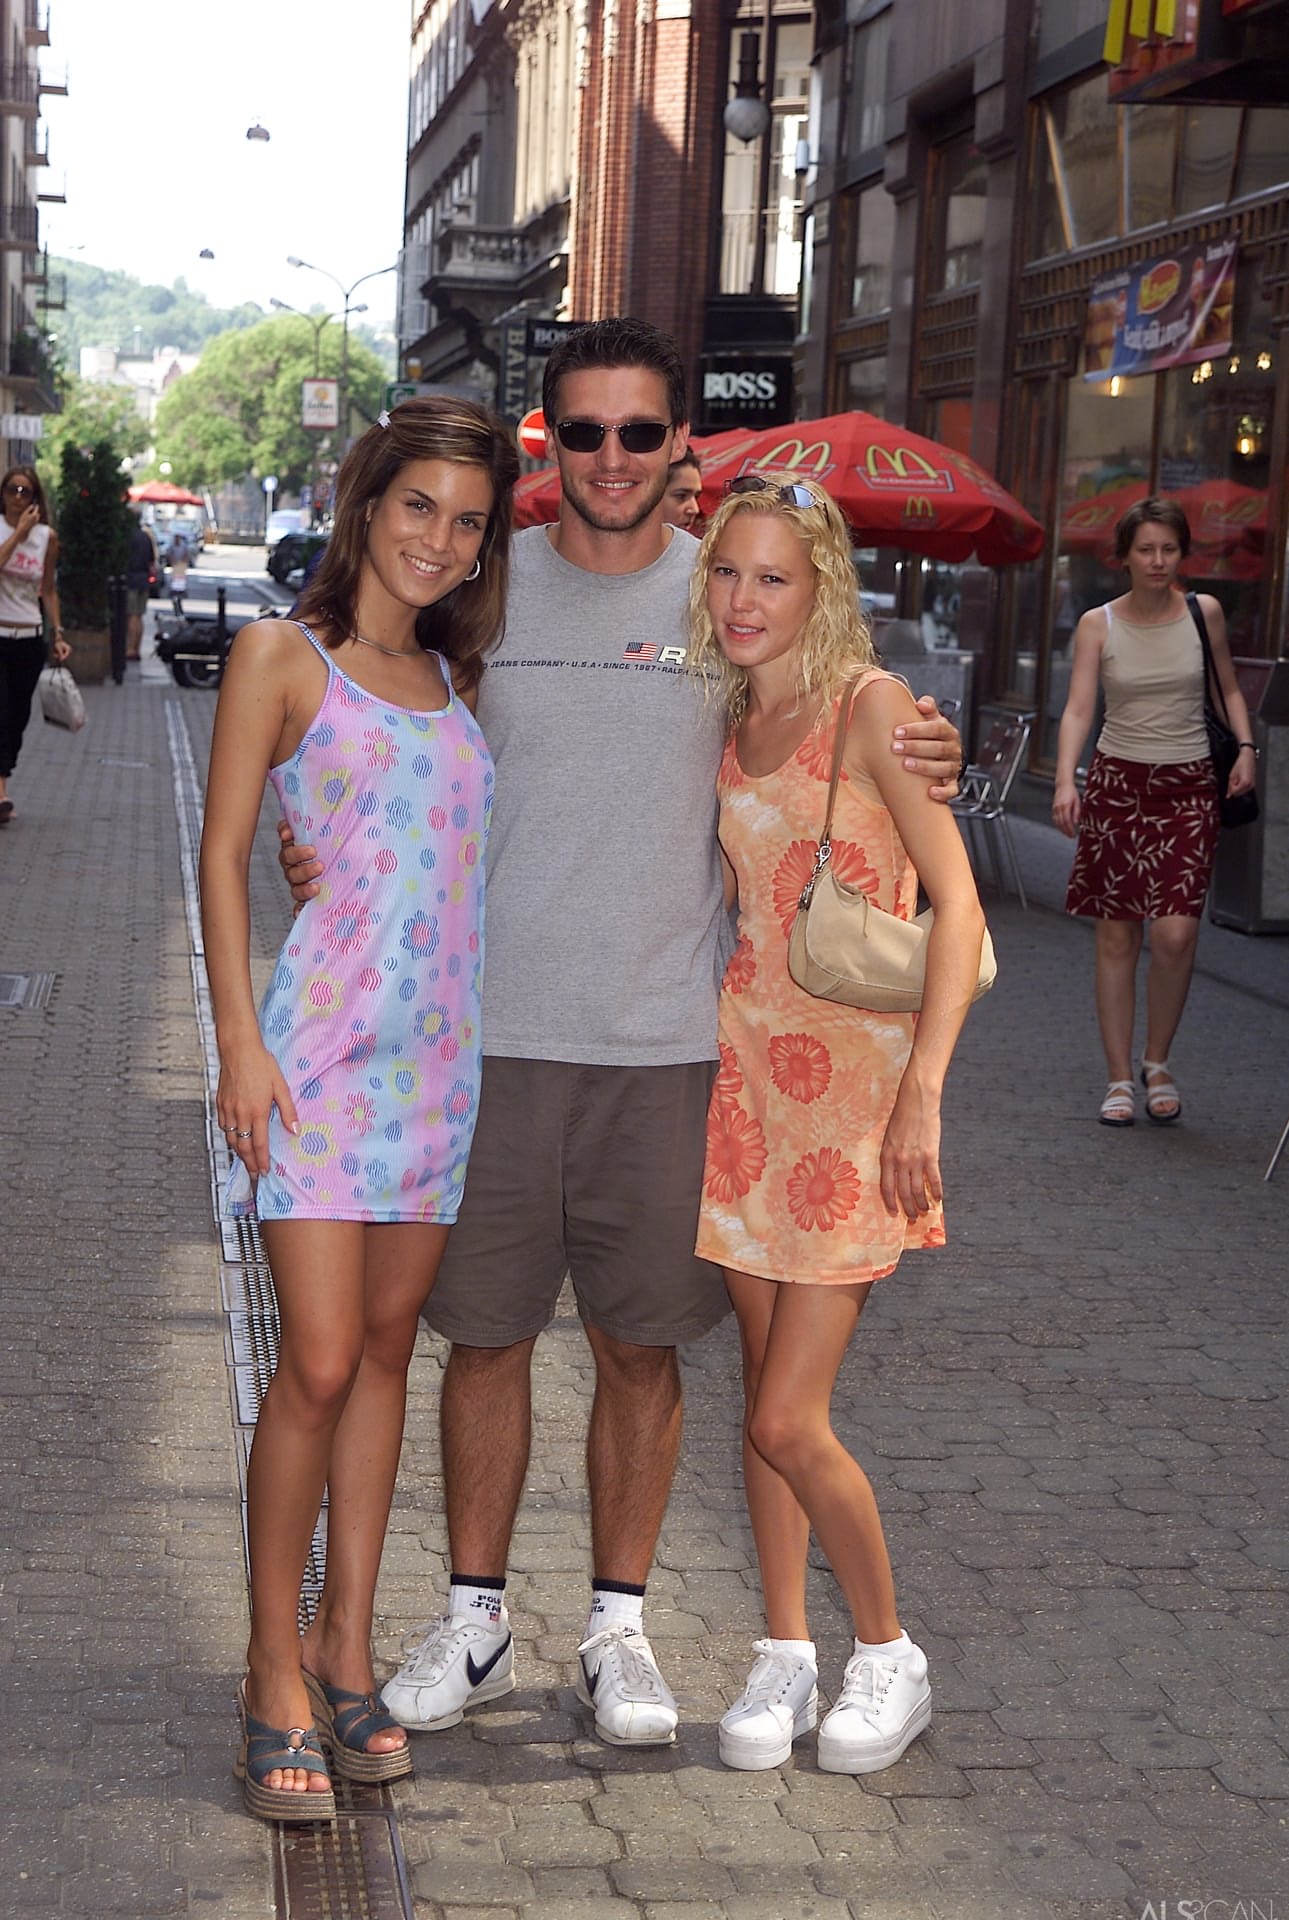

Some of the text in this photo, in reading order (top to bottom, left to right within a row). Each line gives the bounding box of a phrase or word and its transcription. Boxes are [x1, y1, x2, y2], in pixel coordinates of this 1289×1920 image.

[505, 328, 527, 419] BALLY
[703, 371, 777, 400] BOSS
[490, 660, 518, 669] JEANS
[520, 660, 565, 668] COMPANY
[602, 661, 630, 670] SINCE
[657, 645, 690, 666] R
